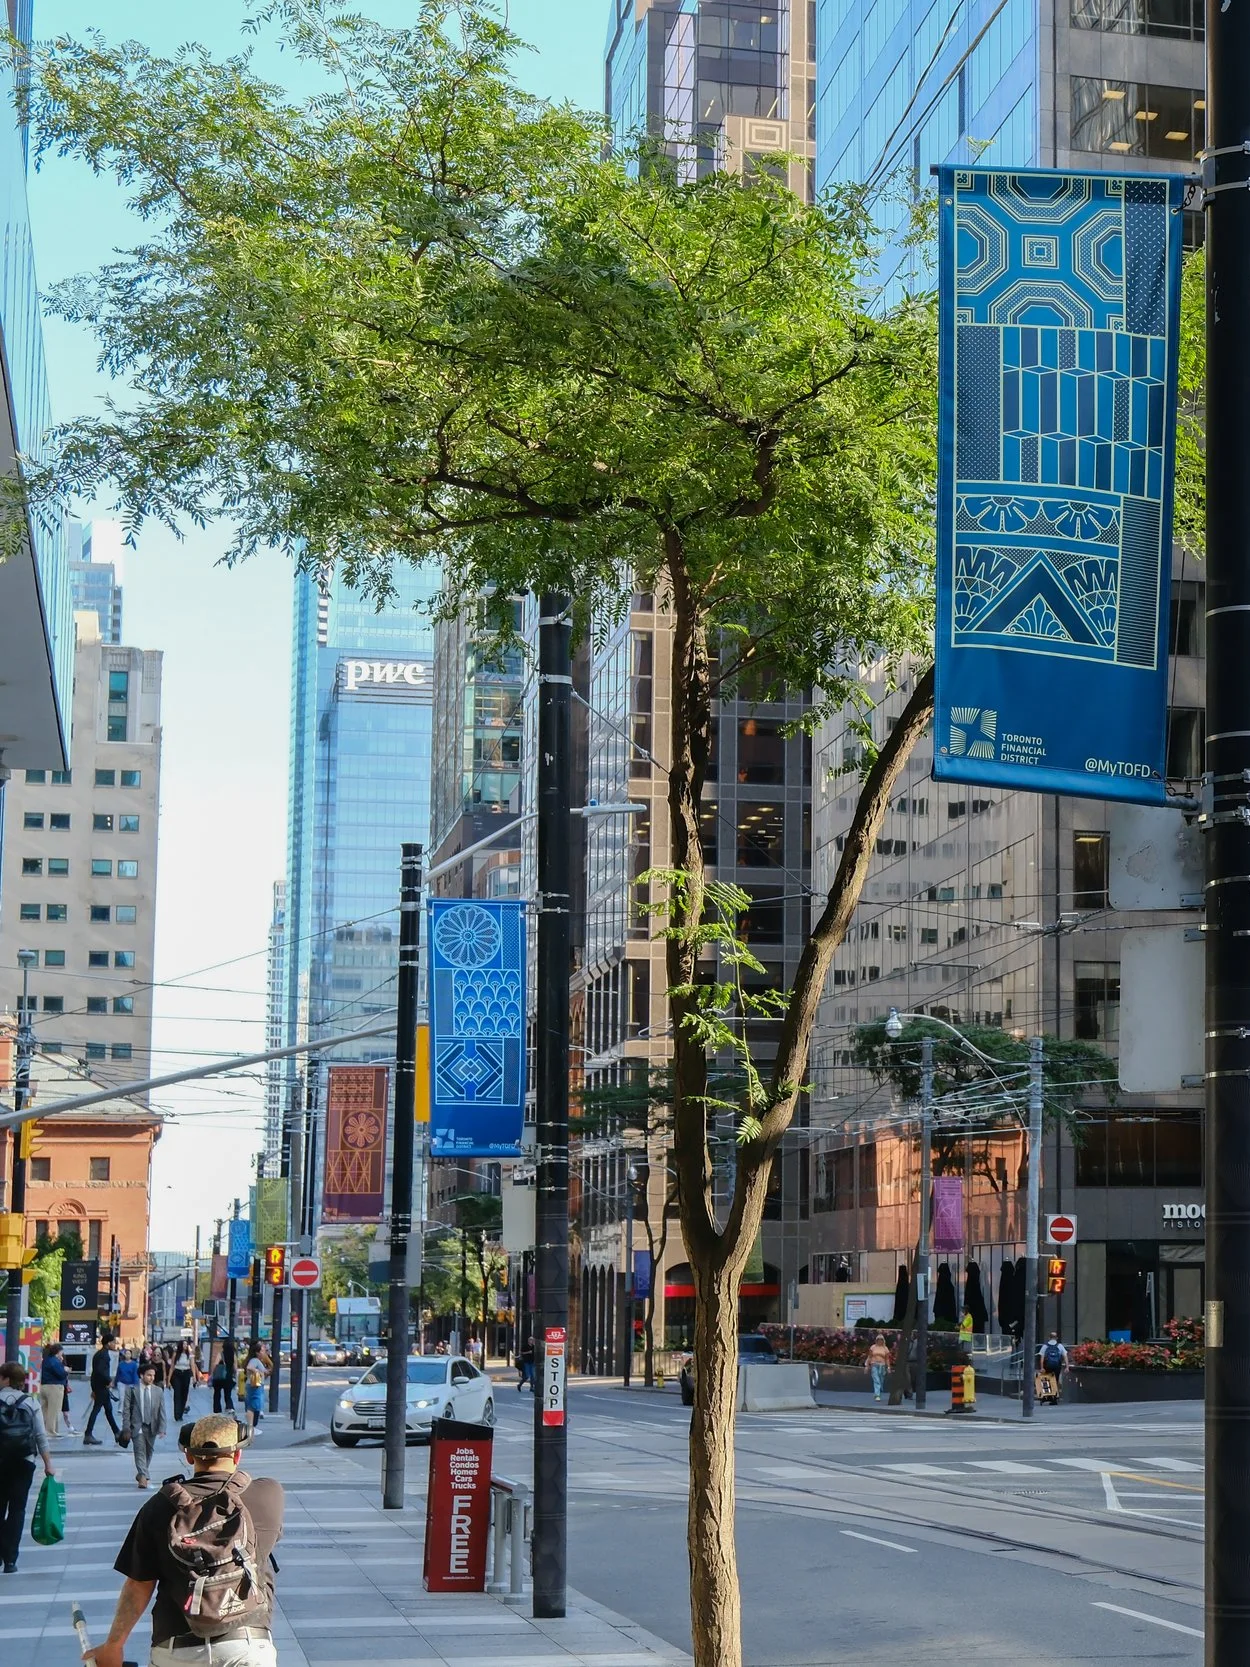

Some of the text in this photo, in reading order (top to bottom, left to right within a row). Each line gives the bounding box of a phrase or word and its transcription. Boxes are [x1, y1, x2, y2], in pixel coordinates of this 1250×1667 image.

[343, 661, 426, 690] pwc
[1002, 733, 1042, 746] TORONTO
[1001, 743, 1047, 756] FINANCIAL
[1000, 753, 1039, 765] DISTRICT
[1085, 757, 1151, 778] @MyTOFD
[1054, 1279, 1062, 1292] 2
[549, 1358, 560, 1409] STOP
[456, 1447, 474, 1455] Jobs
[450, 1454, 479, 1462] Rentals
[449, 1461, 479, 1469] Condos
[450, 1468, 478, 1476] Homes
[454, 1475, 473, 1483] Cars
[450, 1482, 477, 1490] Trucks
[449, 1495, 472, 1574] FREE
